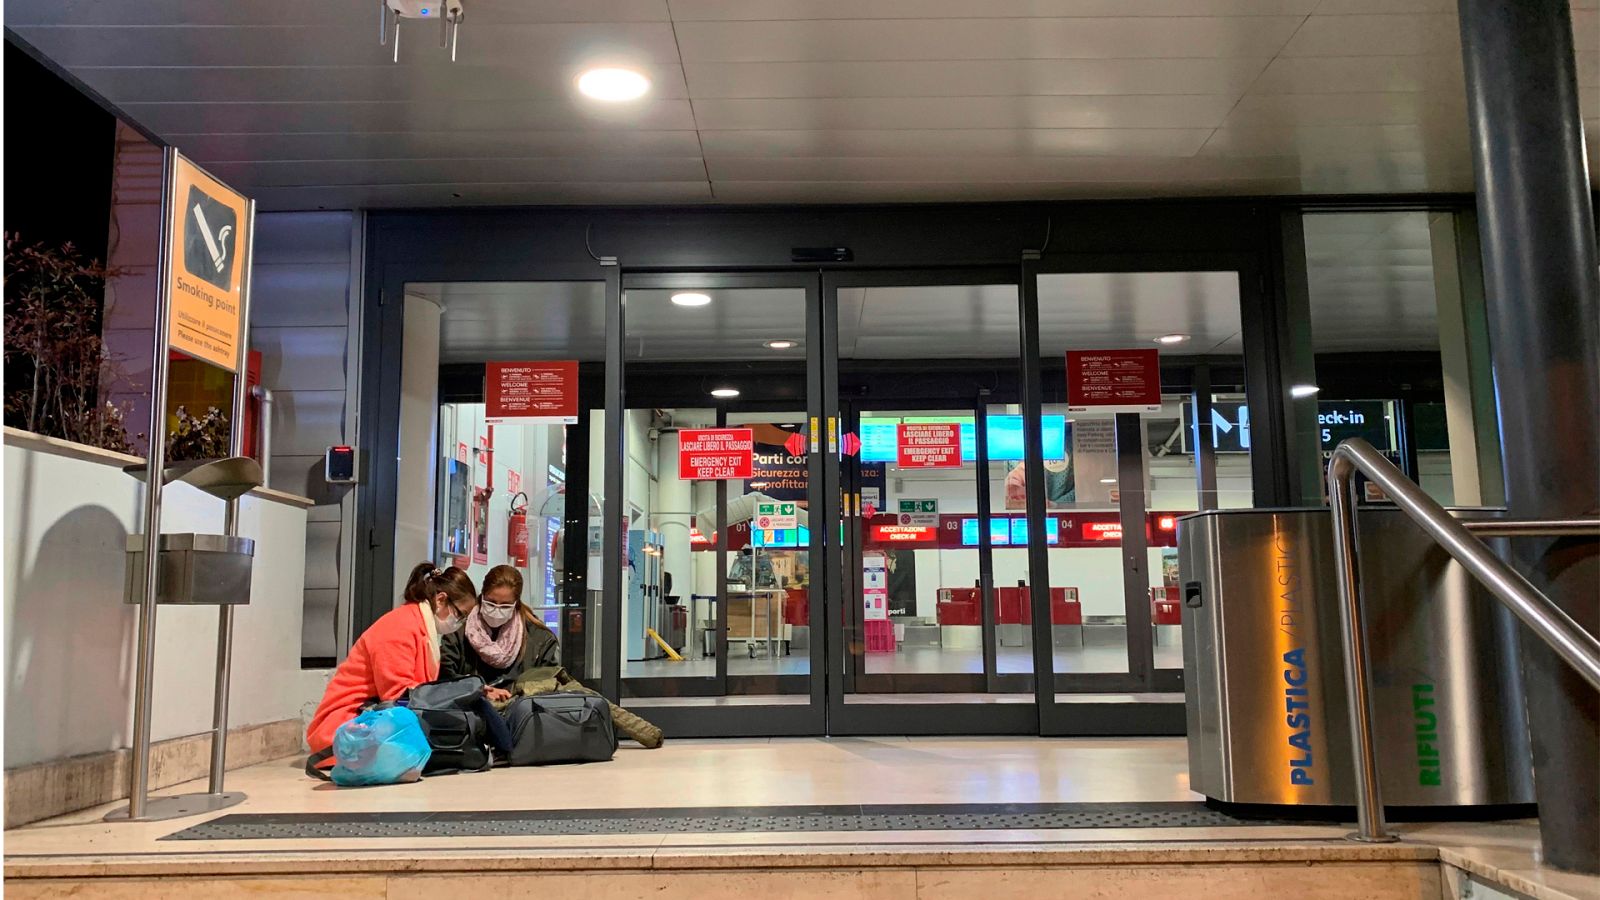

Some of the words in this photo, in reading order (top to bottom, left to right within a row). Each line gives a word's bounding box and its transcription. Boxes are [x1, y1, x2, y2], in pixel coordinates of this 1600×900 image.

[176, 276, 214, 307] Smoking
[215, 298, 236, 316] point
[177, 329, 194, 342] Please
[194, 336, 203, 346] use
[213, 345, 230, 359] ashtray
[1318, 410, 1365, 424] eck-in
[681, 441, 703, 451] LASCIARE
[703, 441, 720, 451] LIBERO
[720, 441, 725, 450] IL
[725, 440, 751, 450] PASSAGGIO
[690, 457, 728, 467] EMERGENCY
[728, 456, 742, 466] EXIT
[752, 453, 783, 465] Parti
[697, 467, 714, 477] KEEP
[714, 467, 735, 477] CLEAR
[752, 468, 800, 478] Sicurezza
[736, 523, 747, 532] 01
[946, 521, 958, 530] 03
[1061, 519, 1073, 529] 04
[1092, 523, 1122, 531] ACCETTA
[888, 607, 906, 616] porti
[1283, 647, 1313, 786] PLASTICA
[1412, 683, 1441, 786] RIFIUTI
